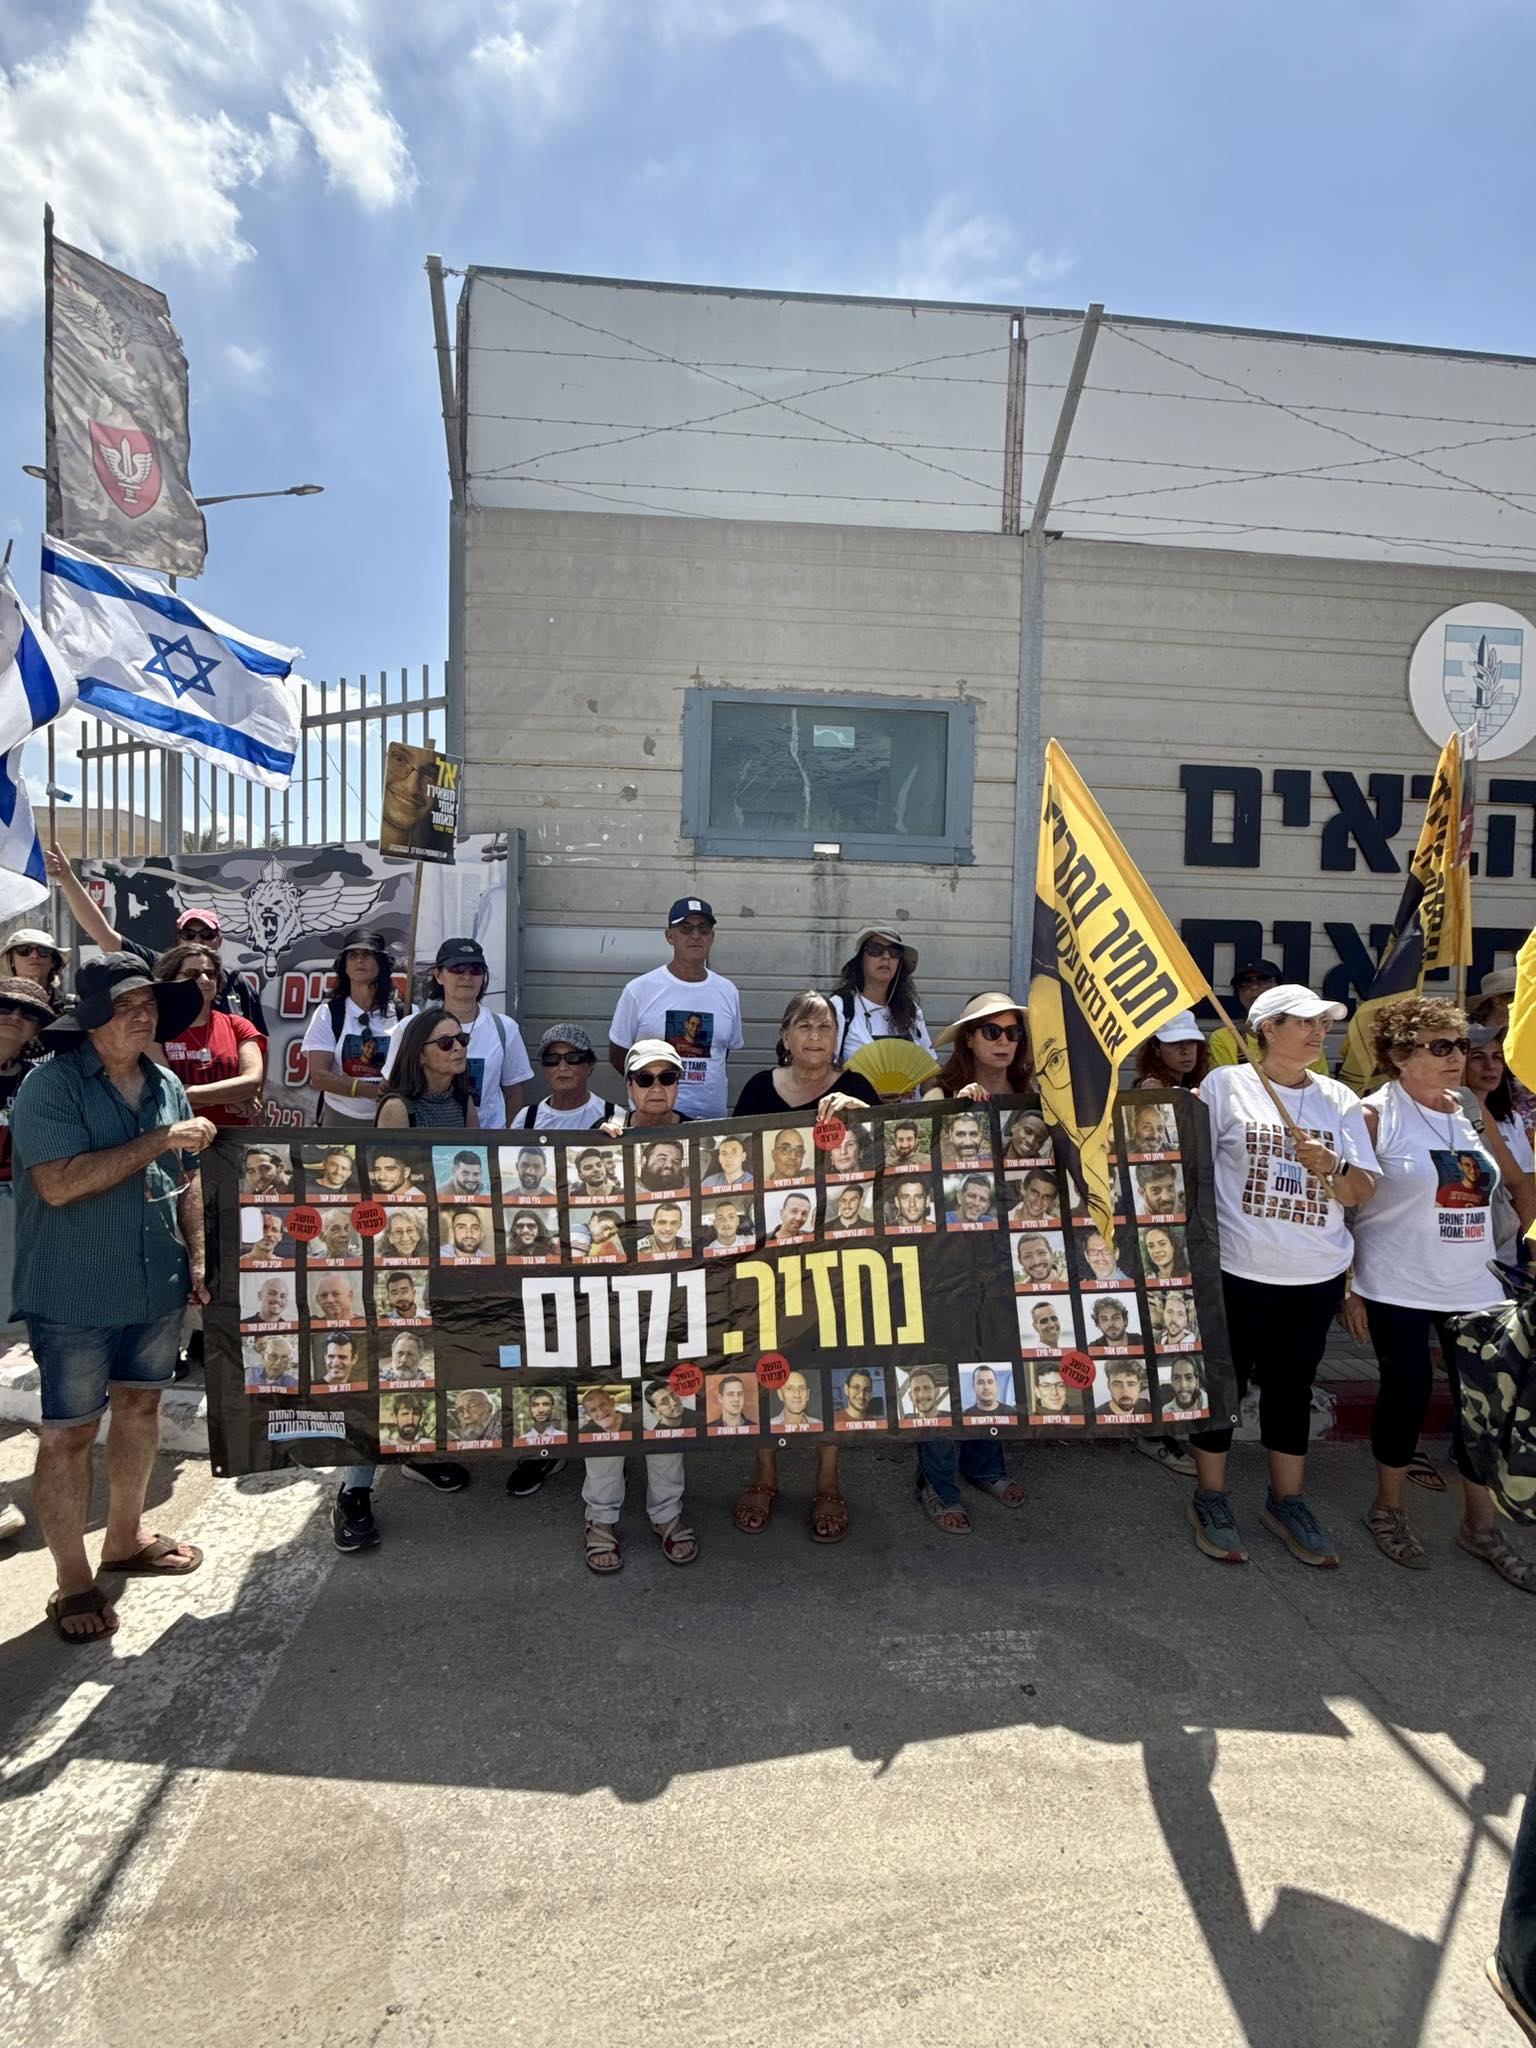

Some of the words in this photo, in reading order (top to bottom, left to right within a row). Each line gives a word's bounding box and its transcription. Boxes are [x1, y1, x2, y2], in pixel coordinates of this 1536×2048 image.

[435, 757, 458, 790] אל
[426, 784, 456, 802] תשאירו
[438, 800, 455, 815] אותי
[431, 811, 454, 826] מאחור
[1089, 907, 1179, 1029] תמיר
[1074, 962, 1107, 1022] כולם
[1098, 1011, 1128, 1057] את
[294, 1213, 315, 1224] הושב
[358, 1208, 379, 1219] הושב
[1438, 1212, 1464, 1224] BRING
[289, 1223, 318, 1234] לקבורה
[356, 1217, 383, 1230] לקבורה
[1440, 1226, 1464, 1238] HOME
[1464, 1225, 1485, 1238] NOW!
[762, 1360, 782, 1371] הושב
[1070, 1357, 1090, 1374] הושב
[675, 1370, 695, 1381] הושב
[760, 1369, 786, 1382] לקבורה
[1061, 1364, 1089, 1385] לקבורה
[674, 1377, 700, 1392] לקבורה
[268, 1409, 295, 1421] להחזרת
[296, 1410, 328, 1421] המשפחות
[329, 1412, 344, 1421] מטה
[268, 1421, 308, 1436] והנעדרים
[310, 1421, 346, 1434] החטופים
